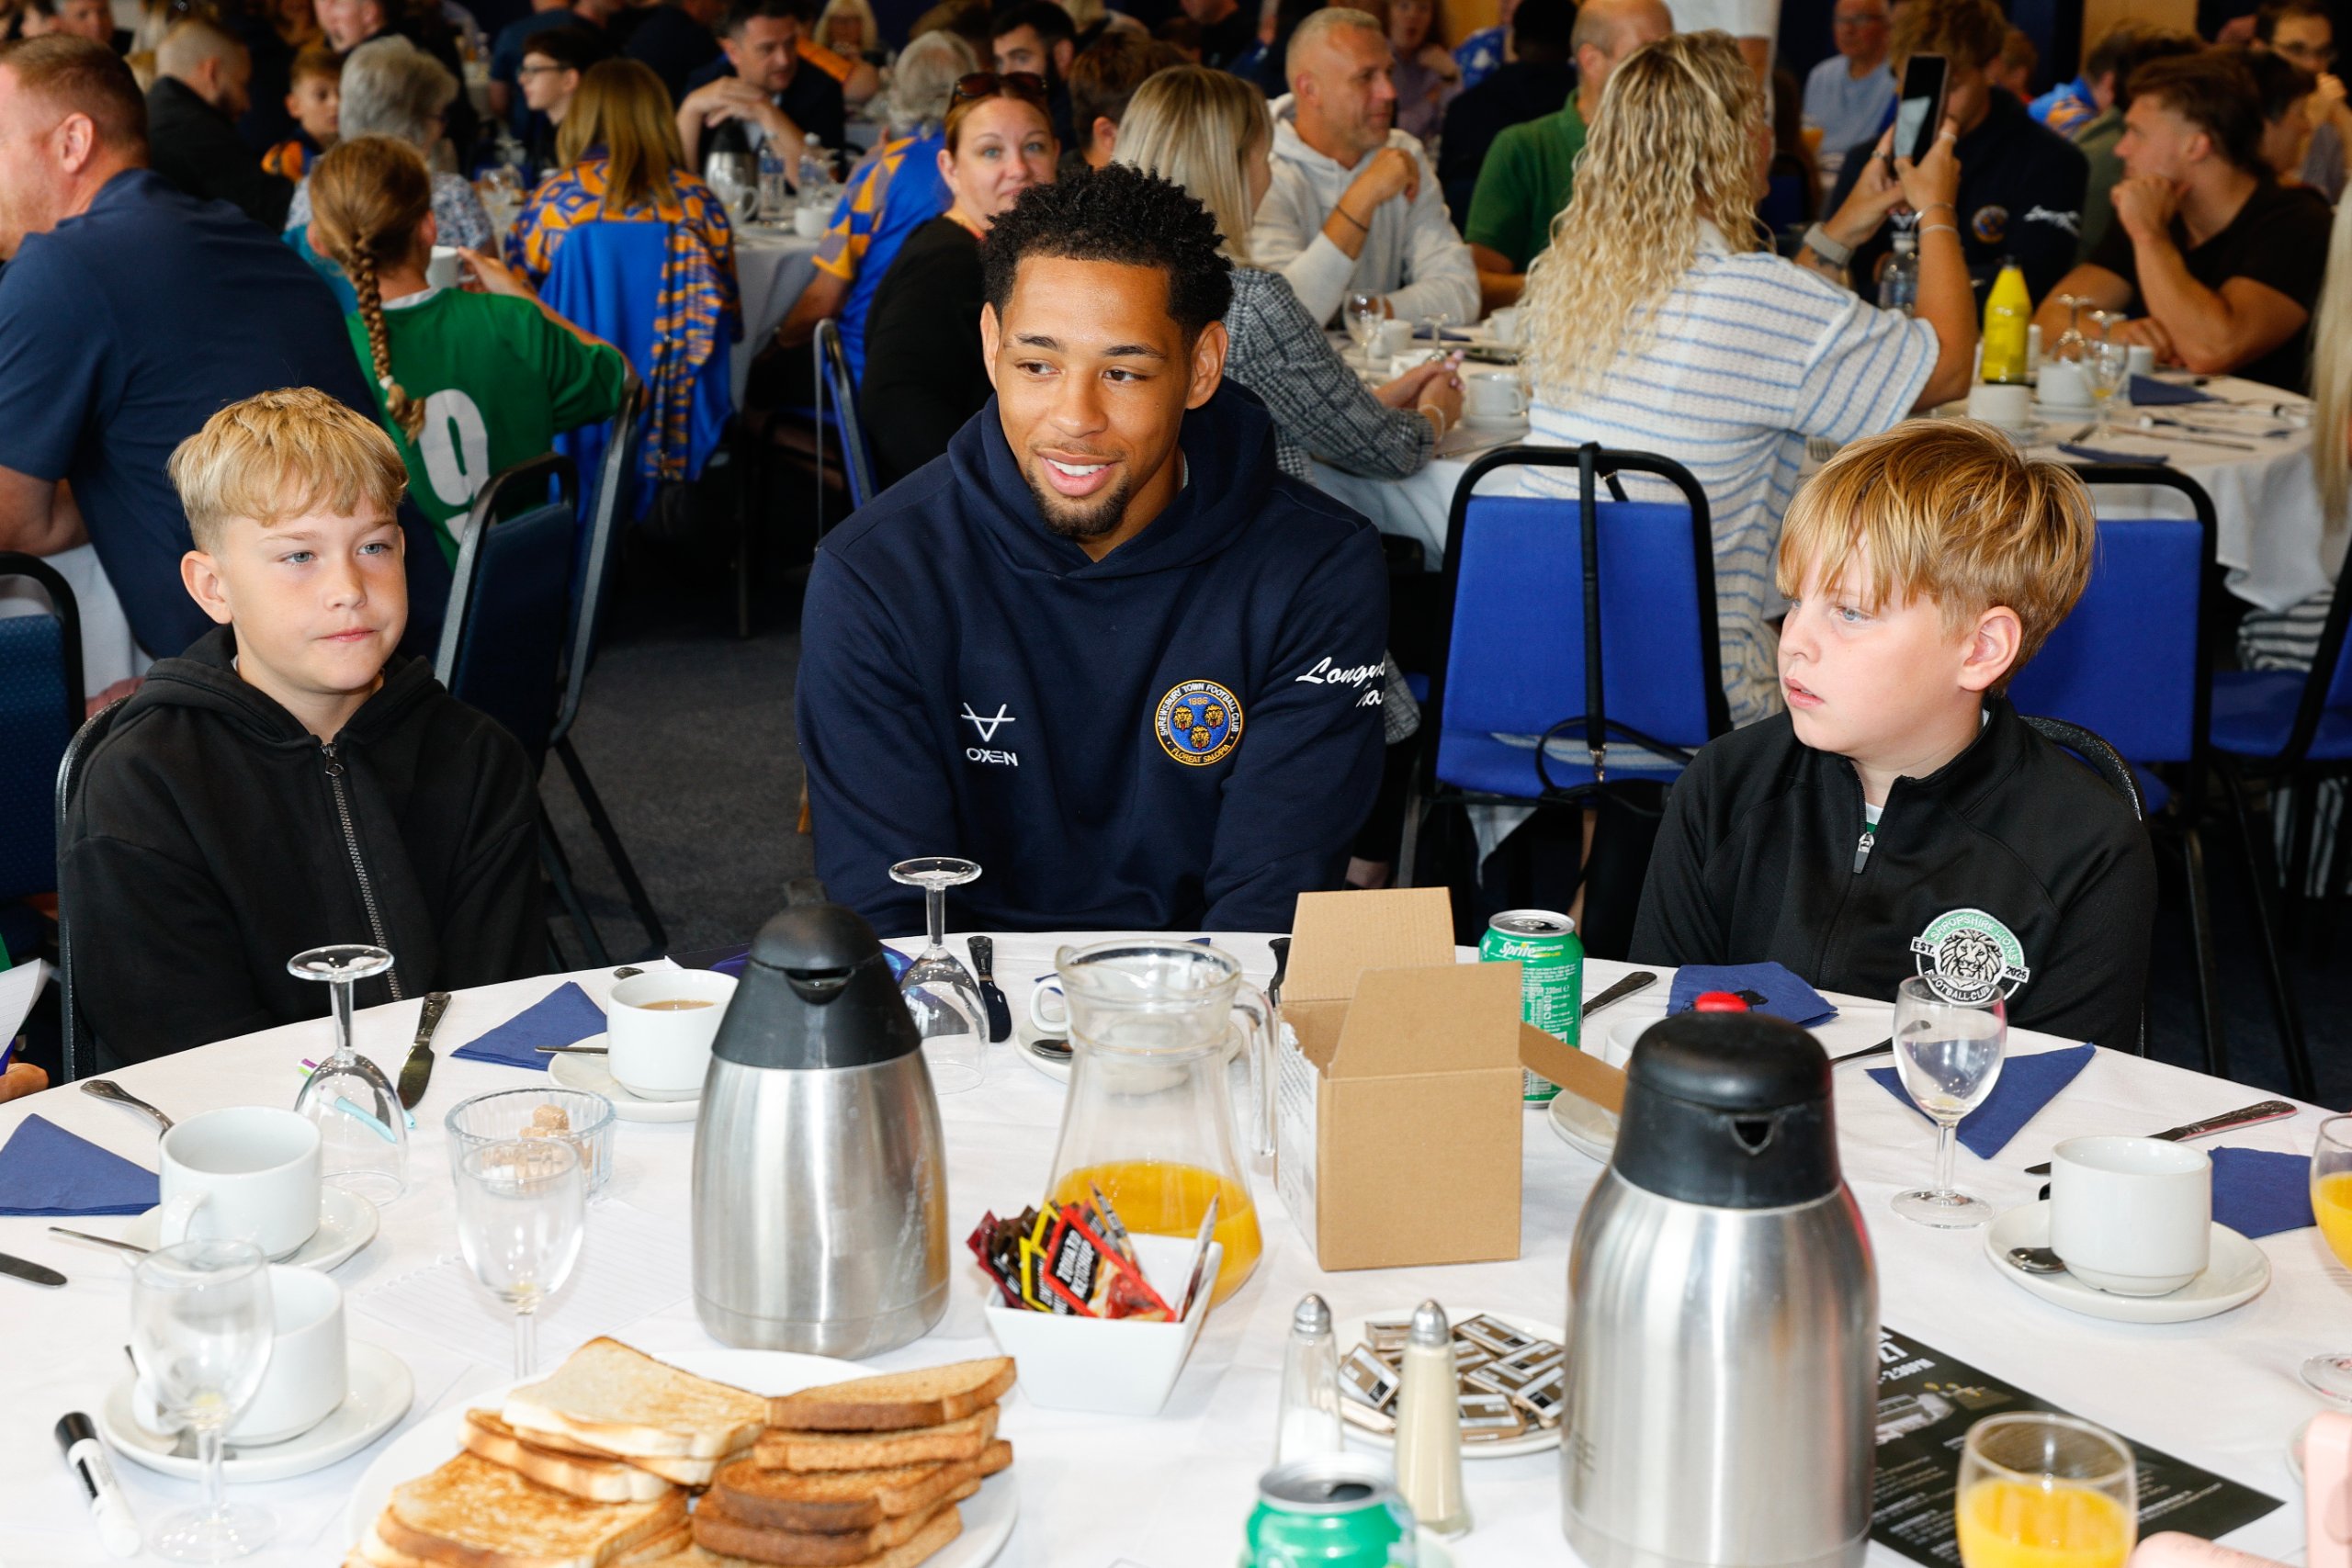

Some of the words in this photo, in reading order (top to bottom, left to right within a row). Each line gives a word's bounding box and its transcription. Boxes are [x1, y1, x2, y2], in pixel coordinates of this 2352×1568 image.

[1158, 689, 1182, 737] SHREWSBURY
[1182, 683, 1204, 694] TOWN
[1206, 684, 1235, 712] FOOTBALL
[1231, 713, 1240, 732] CLUB
[1188, 697, 1209, 706] 1886
[966, 747, 1019, 767] OXEN
[1171, 748, 1201, 763] FLOREAT
[1204, 744, 1231, 762] SALOPIA
[1930, 916, 1996, 941] SHROPSHIRE
[1996, 929, 2018, 961] LIONS
[1499, 941, 1537, 957] Sprite
[1913, 941, 1935, 955] EST.
[2006, 965, 2028, 980] 2025
